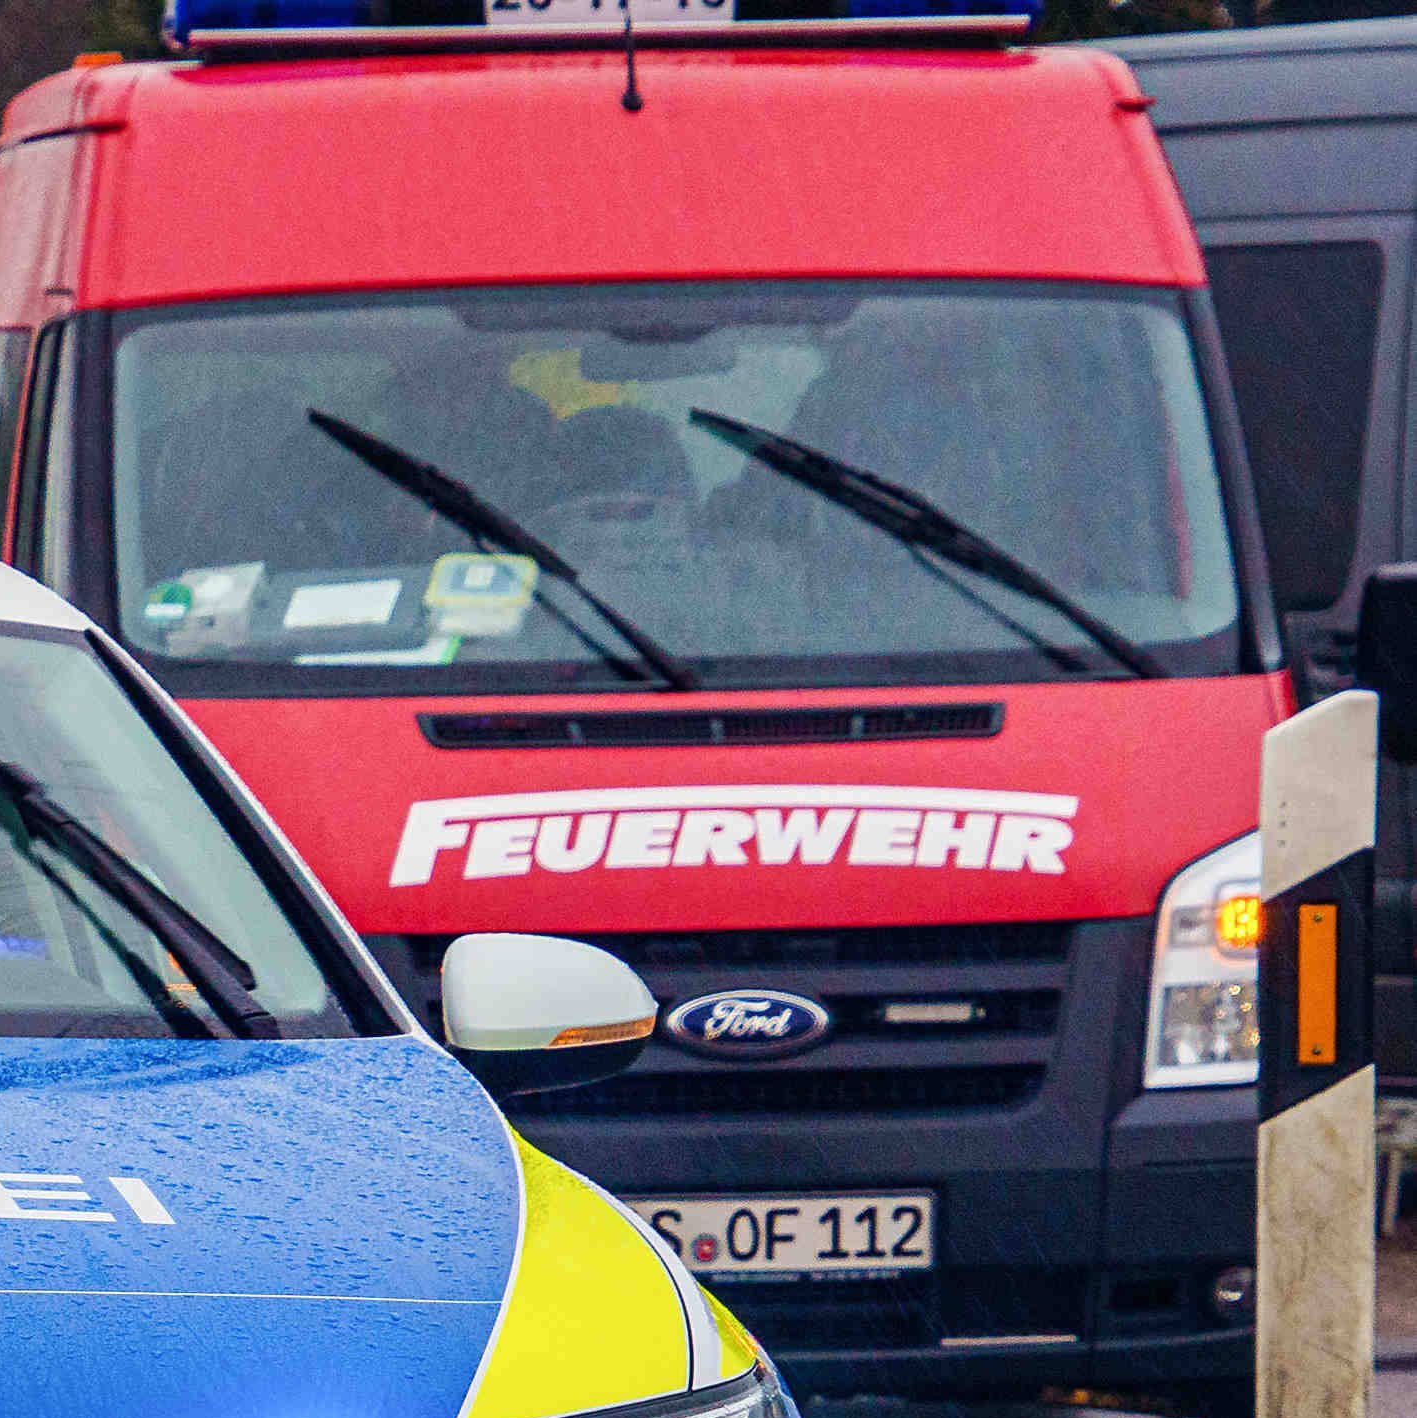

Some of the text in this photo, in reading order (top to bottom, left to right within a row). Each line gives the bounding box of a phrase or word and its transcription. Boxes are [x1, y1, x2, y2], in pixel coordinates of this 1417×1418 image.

[388, 784, 1079, 888] FEUERWEHR
[703, 999, 793, 1041] Ford
[725, 1206, 801, 1263] OF
[816, 1205, 924, 1261] 112
